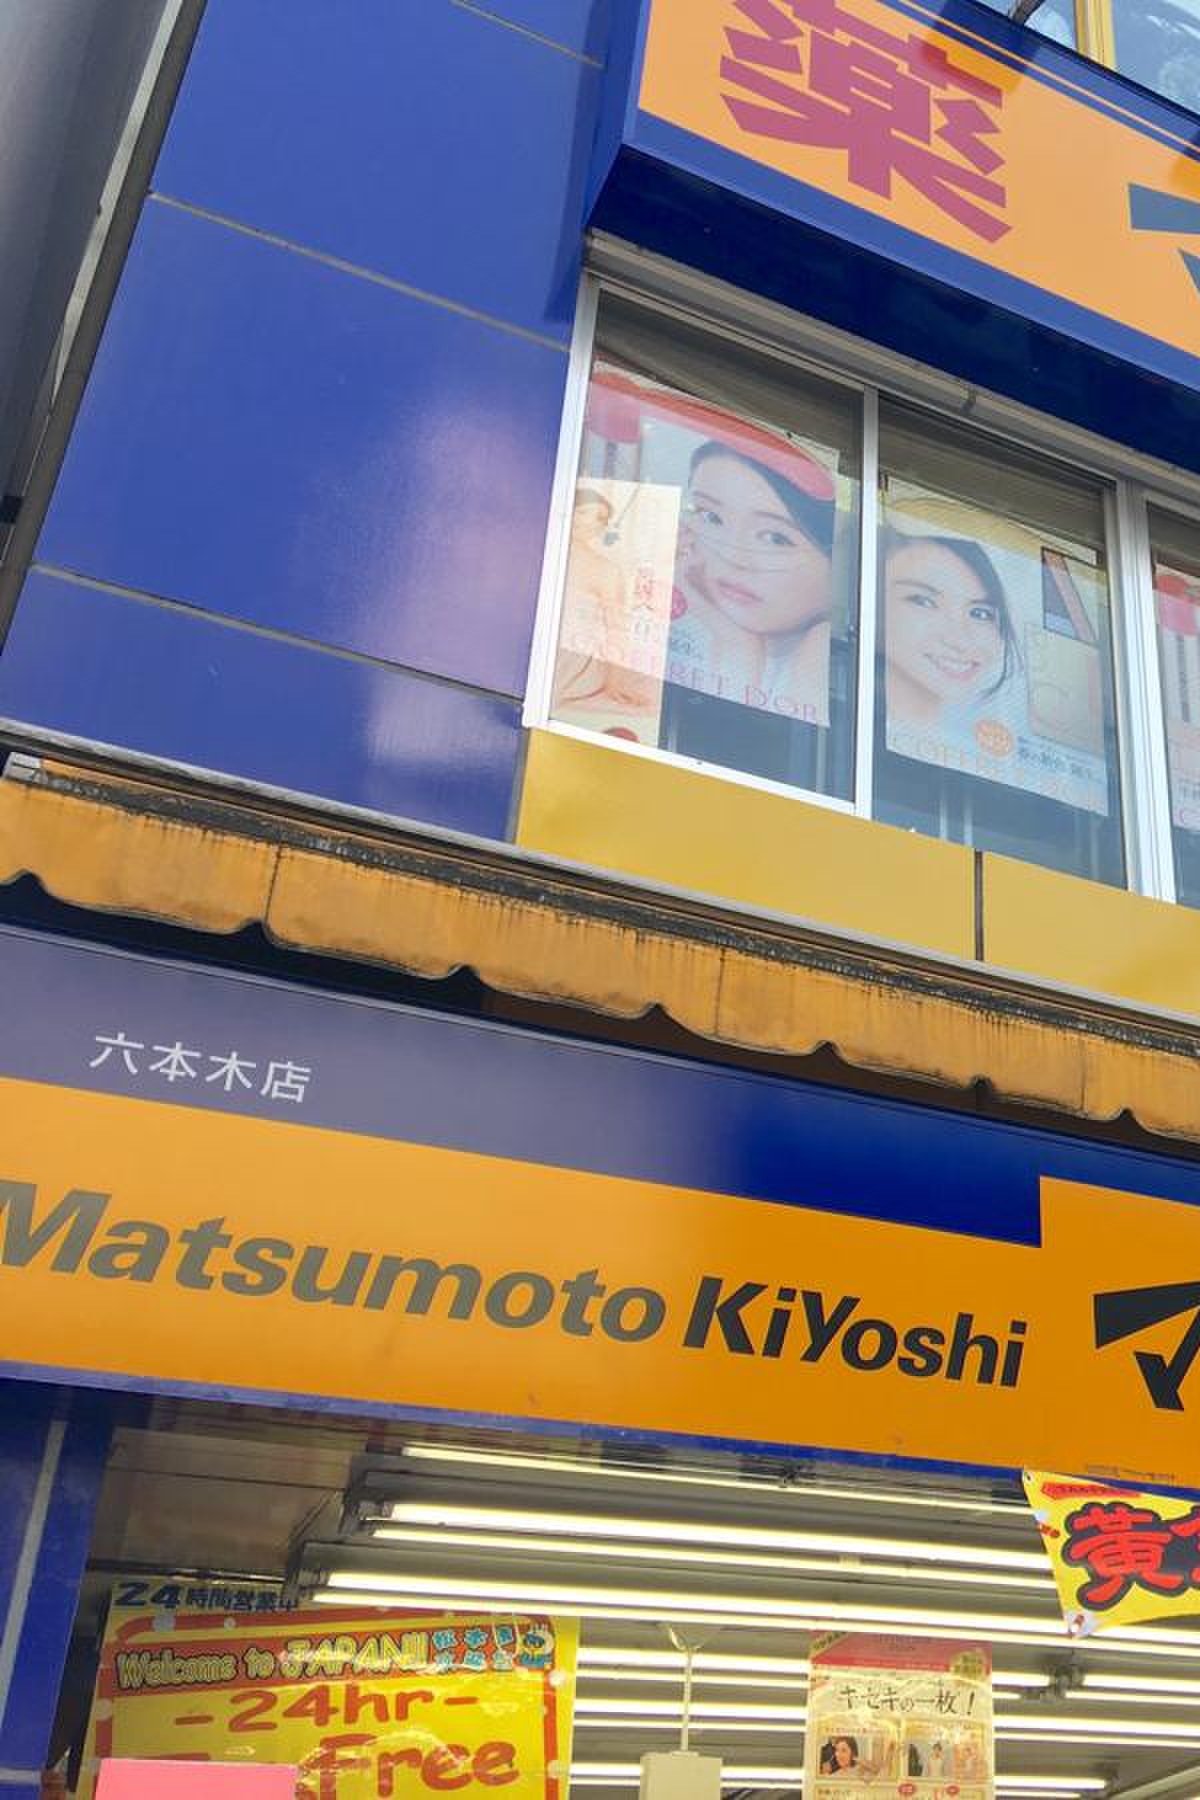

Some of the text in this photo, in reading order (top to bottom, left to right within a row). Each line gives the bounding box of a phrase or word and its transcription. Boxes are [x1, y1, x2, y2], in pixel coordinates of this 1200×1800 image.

[720, 0, 1012, 244] 薬
[88, 1031, 313, 1103] 六本木店
[0, 1180, 1027, 1388] Matsumoto KiYoshi
[116, 1648, 238, 1690] Welcome
[242, 1646, 275, 1680] to
[312, 1732, 520, 1800] Free
